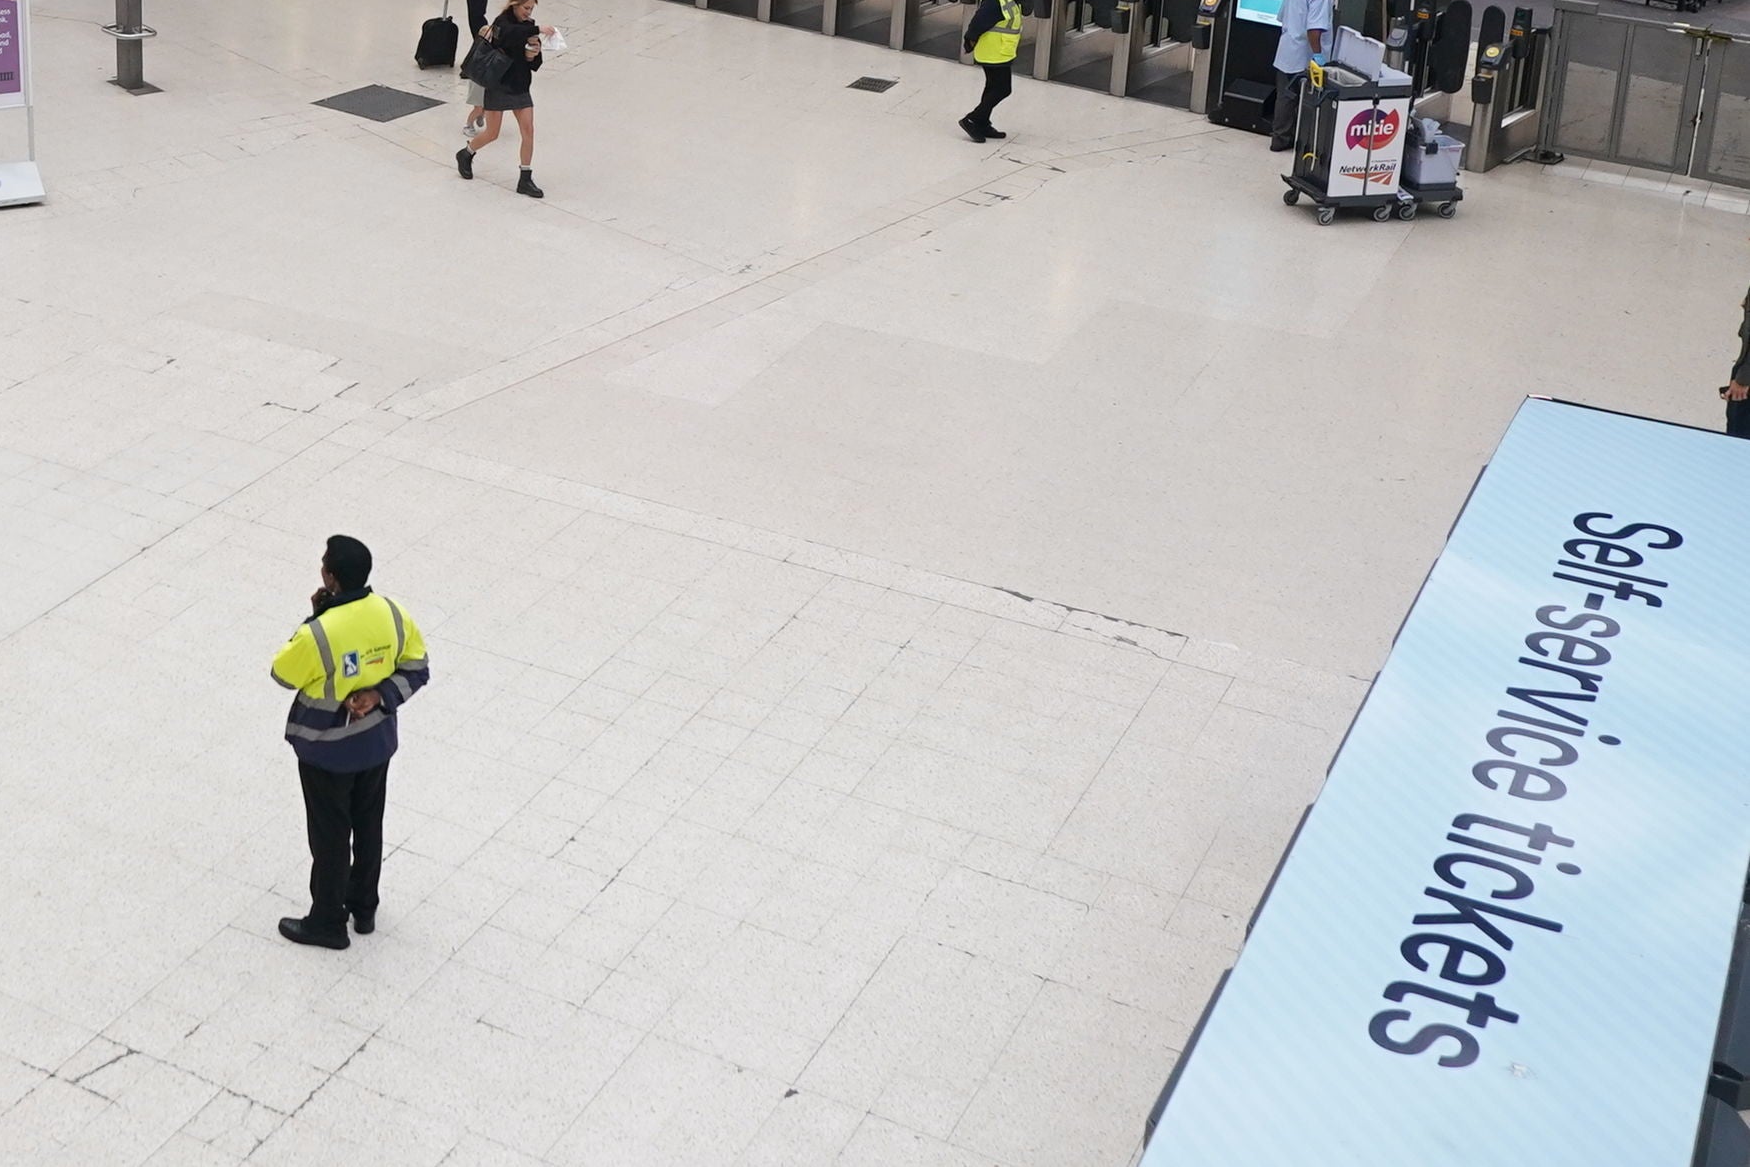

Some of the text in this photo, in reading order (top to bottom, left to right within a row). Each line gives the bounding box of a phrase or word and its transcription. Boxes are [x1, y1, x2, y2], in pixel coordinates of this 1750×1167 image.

[1350, 119, 1394, 137] mitie
[1367, 511, 1684, 1070] Self-service tickets
